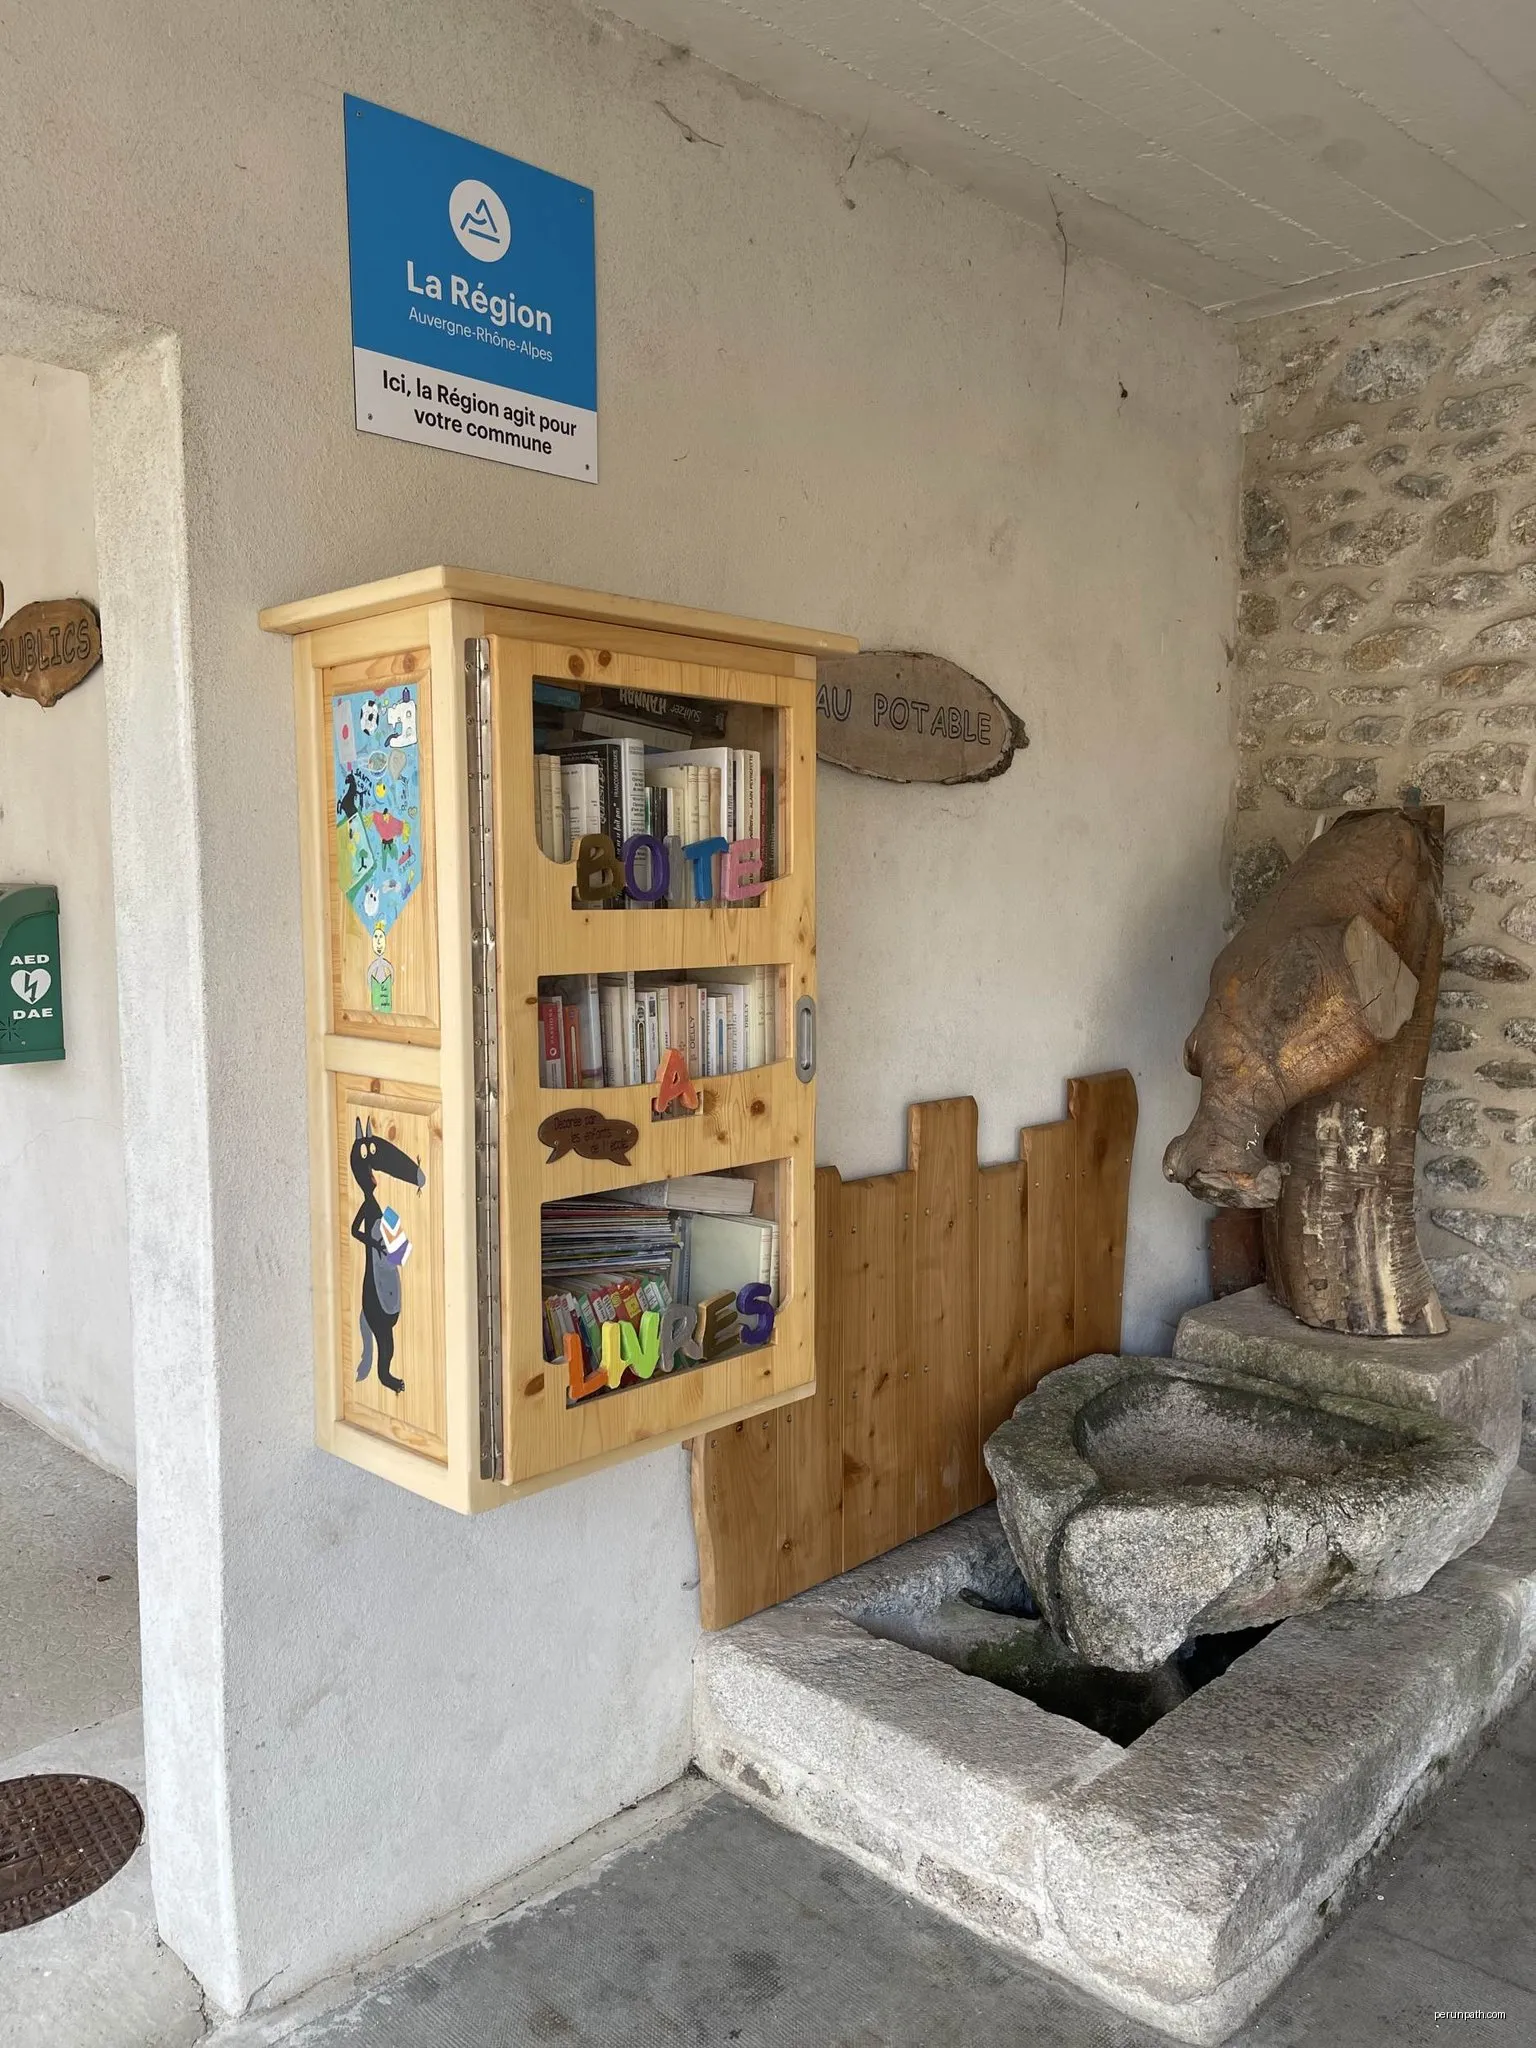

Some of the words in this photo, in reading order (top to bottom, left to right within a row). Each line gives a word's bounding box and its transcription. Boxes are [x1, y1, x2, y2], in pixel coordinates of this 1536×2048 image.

[407, 260, 442, 301] La
[451, 273, 553, 335] Région
[409, 306, 553, 362] Auvergne-Rhône-Alpes
[383, 369, 411, 396] Ici,
[417, 377, 432, 401] la
[437, 383, 499, 418] Région
[503, 403, 536, 427] agit
[539, 414, 577, 437] pour
[414, 408, 462, 435] votre
[467, 421, 552, 455] commune
[0, 618, 92, 679] PUBLICS
[620, 688, 667, 715] HANNAH
[670, 704, 702, 723] Sulitzer
[816, 684, 852, 722] AU
[874, 693, 992, 745] POTABLE
[9, 954, 51, 966] AED
[12, 1007, 54, 1020] DAE
[656, 1048, 698, 1112] A
[564, 1282, 776, 1401] LIVRES
